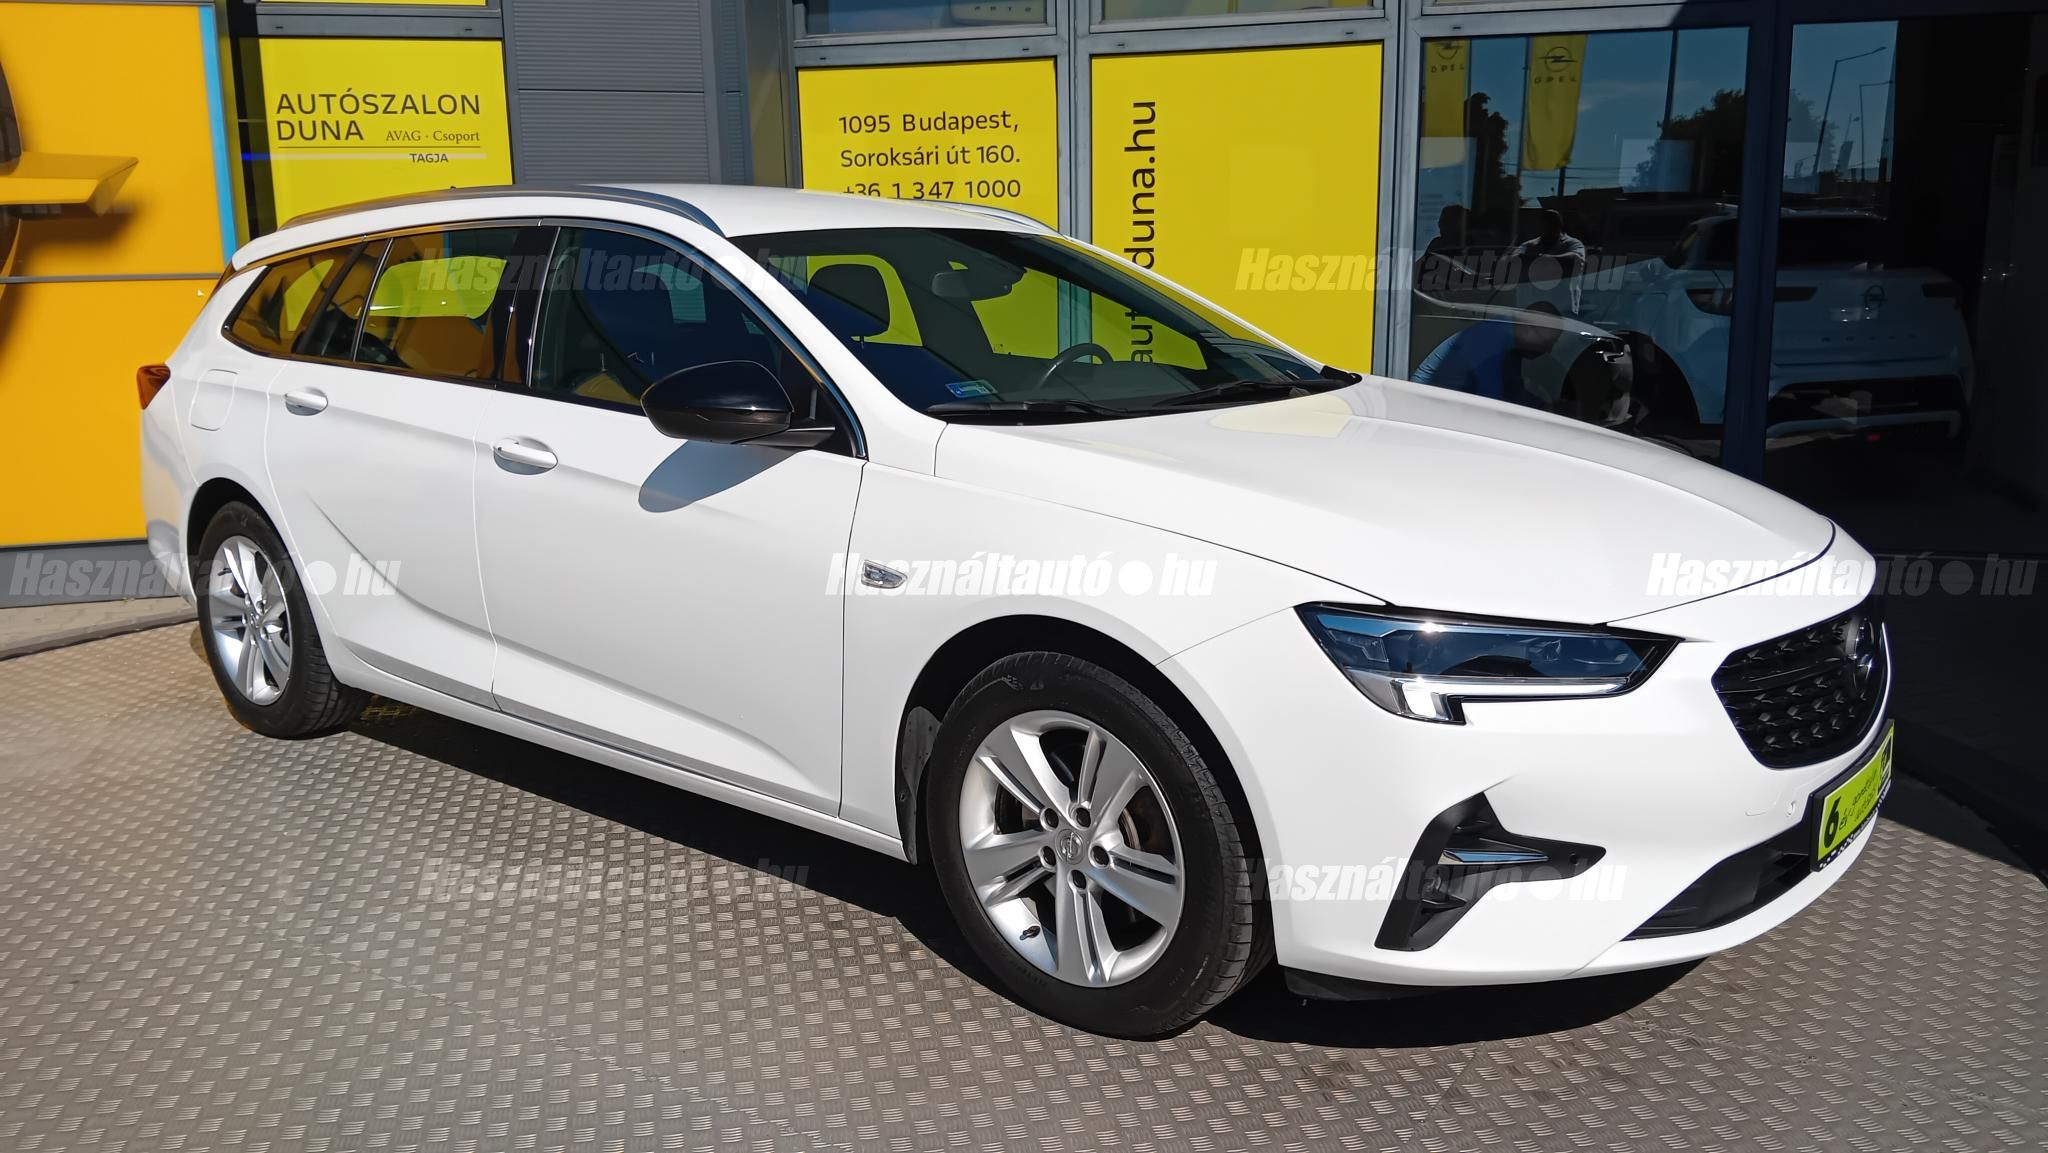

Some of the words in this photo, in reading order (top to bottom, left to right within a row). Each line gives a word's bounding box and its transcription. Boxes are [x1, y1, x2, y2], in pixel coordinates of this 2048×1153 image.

[276, 87, 480, 115] AUTÓSZALON
[277, 120, 364, 141] DUNA
[838, 114, 891, 134] 1095
[902, 110, 1019, 135] Budapest,
[385, 130, 421, 142] AVAG
[432, 130, 480, 144] Csoport
[409, 153, 449, 163] TAGJA
[840, 145, 939, 168] Soroksári
[946, 145, 971, 165] út
[975, 144, 1021, 164] 160.
[891, 182, 901, 199] 1
[912, 181, 954, 199] 347
[964, 179, 1022, 199] 1000
